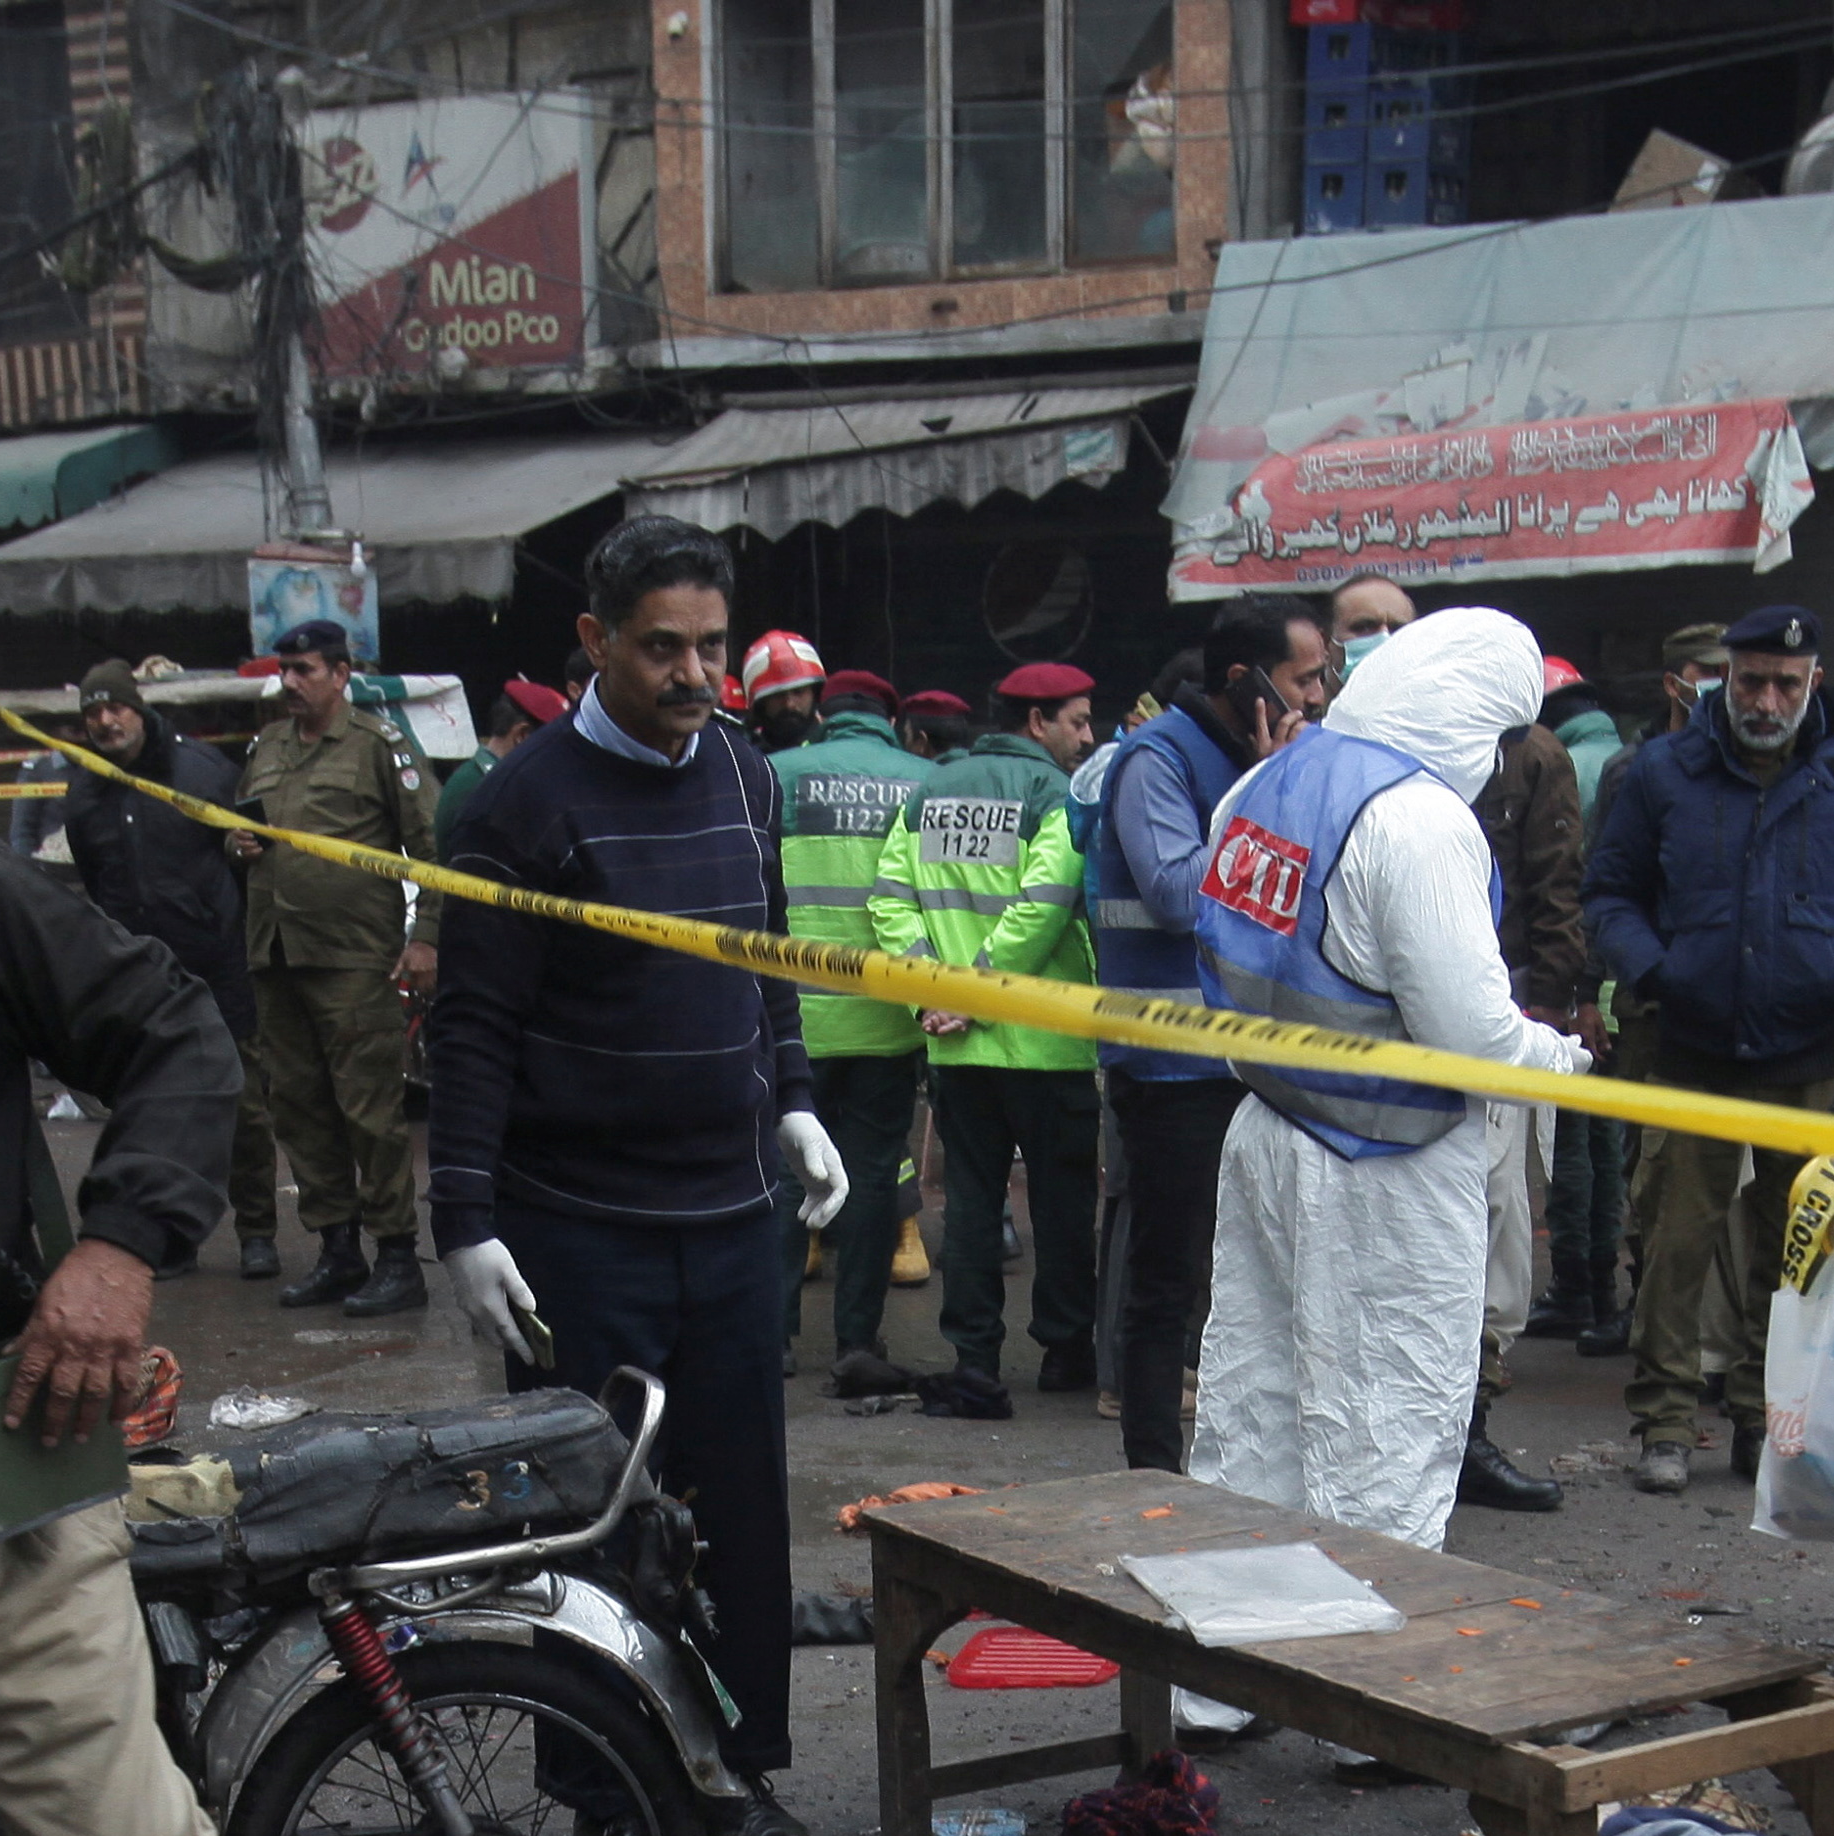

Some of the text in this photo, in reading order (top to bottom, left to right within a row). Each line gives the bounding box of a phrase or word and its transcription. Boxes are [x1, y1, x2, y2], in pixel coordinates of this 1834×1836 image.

[428, 254, 537, 308] Mian
[807, 779, 911, 806] RESCUE
[833, 807, 885, 832] 1122
[922, 805, 1017, 833] RESCUE
[942, 833, 990, 858] 1122
[1217, 832, 1306, 919] CTD
[1782, 1189, 1832, 1283] CROSS
